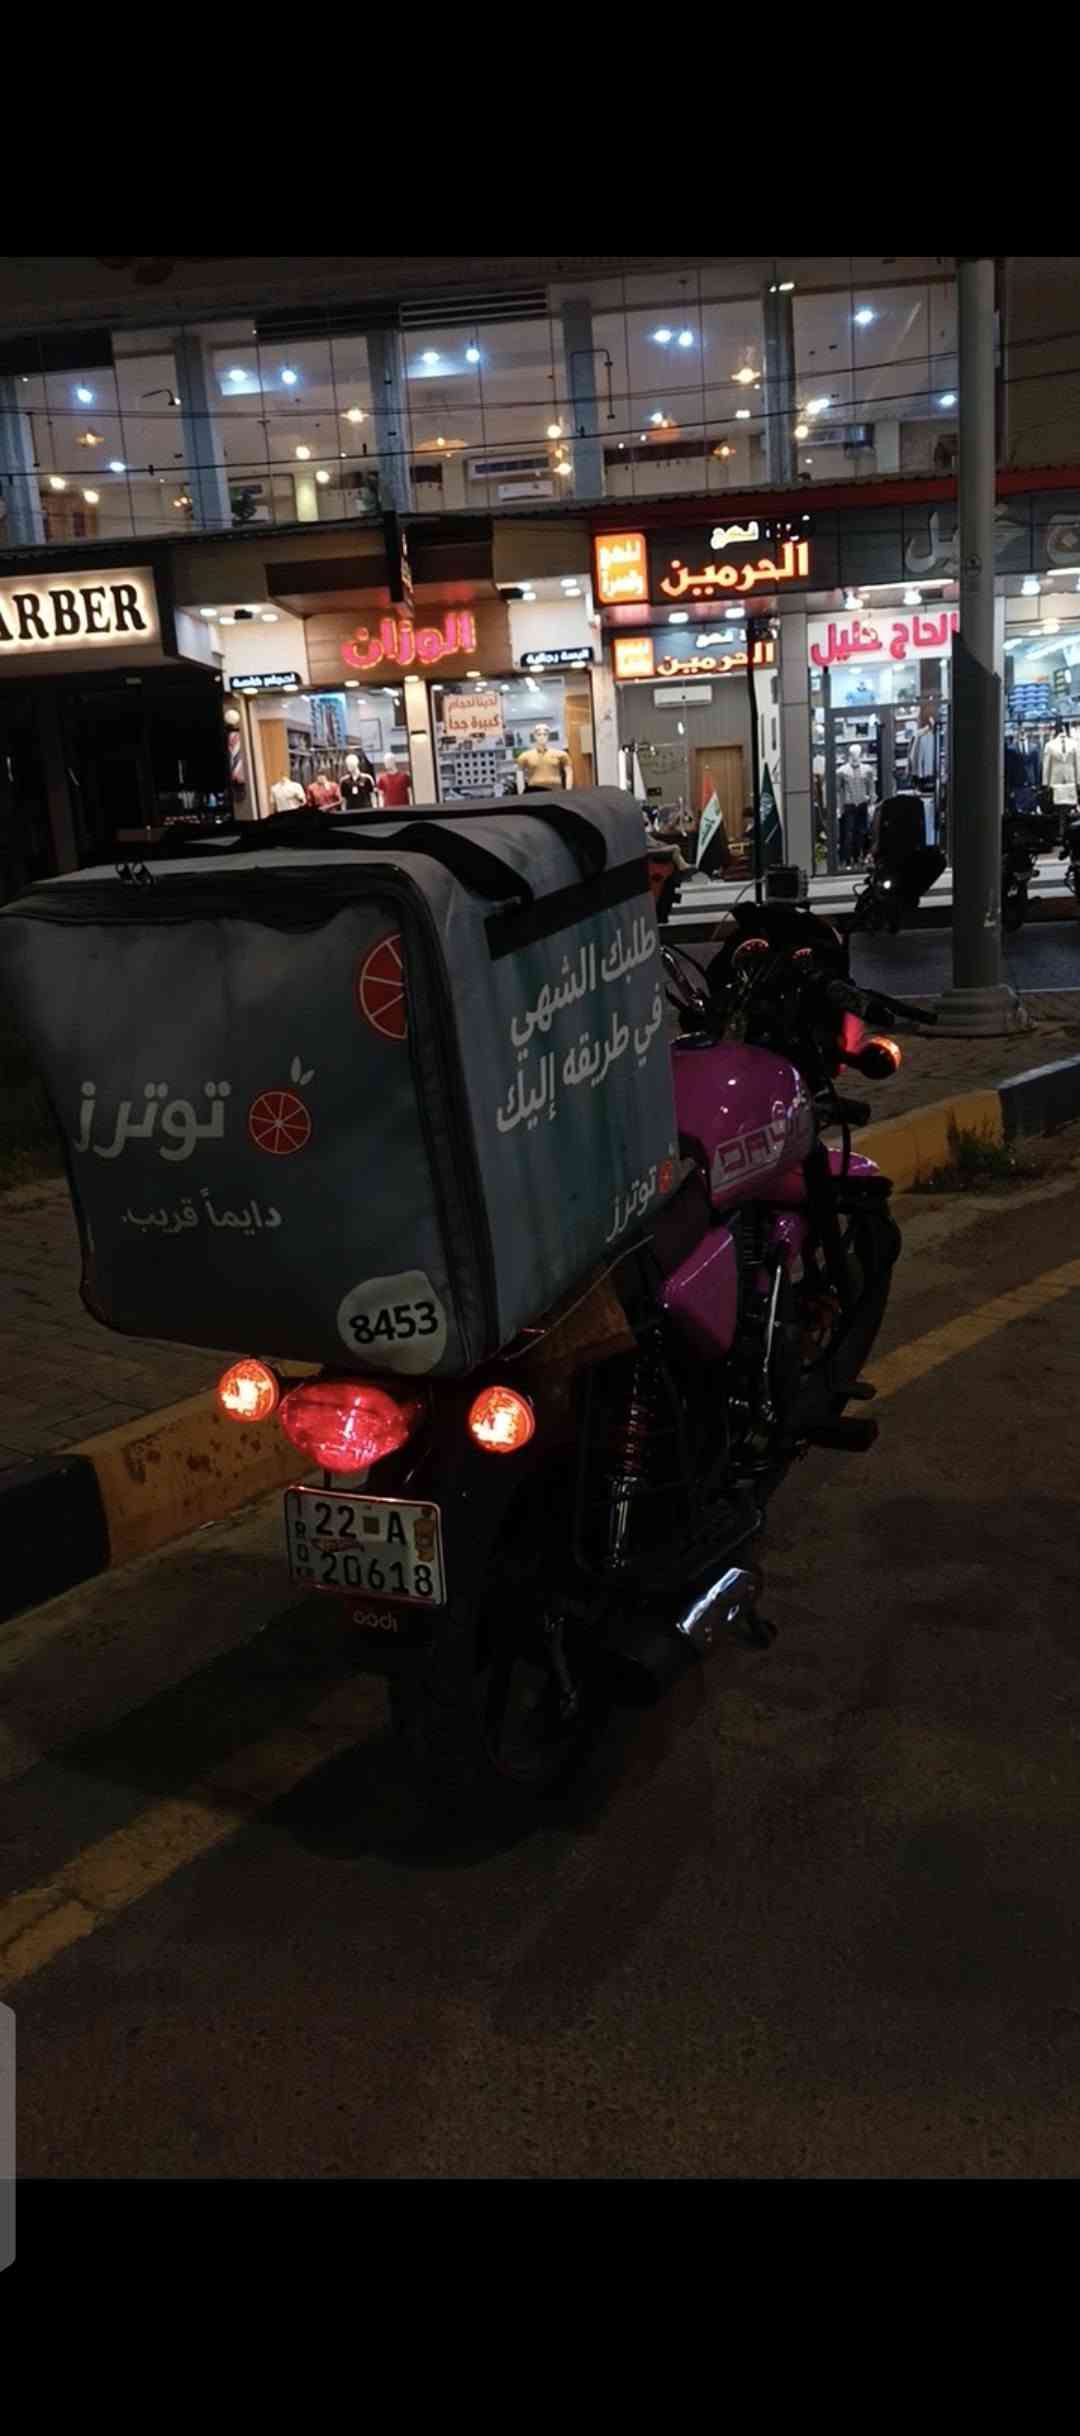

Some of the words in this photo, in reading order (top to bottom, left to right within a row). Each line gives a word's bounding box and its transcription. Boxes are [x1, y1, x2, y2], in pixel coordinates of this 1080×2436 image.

[661, 541, 809, 596] الحرمين
[341, 611, 477, 669] الوزان
[657, 641, 775, 675] الحرمين
[889, 610, 960, 660] الحاج
[471, 713, 499, 731] كبيرة
[600, 916, 658, 985] طلبك
[510, 943, 597, 1063] الشهي
[633, 981, 664, 1068] في
[561, 1011, 630, 1089] طريقه
[72, 1080, 233, 1161] توترز
[496, 1051, 557, 1134] إليك
[605, 1165, 658, 1243] توترز
[350, 1301, 438, 1344] 8453
[315, 1501, 357, 1539] 22
[386, 1511, 406, 1546] A
[321, 1551, 434, 1597] 20618
